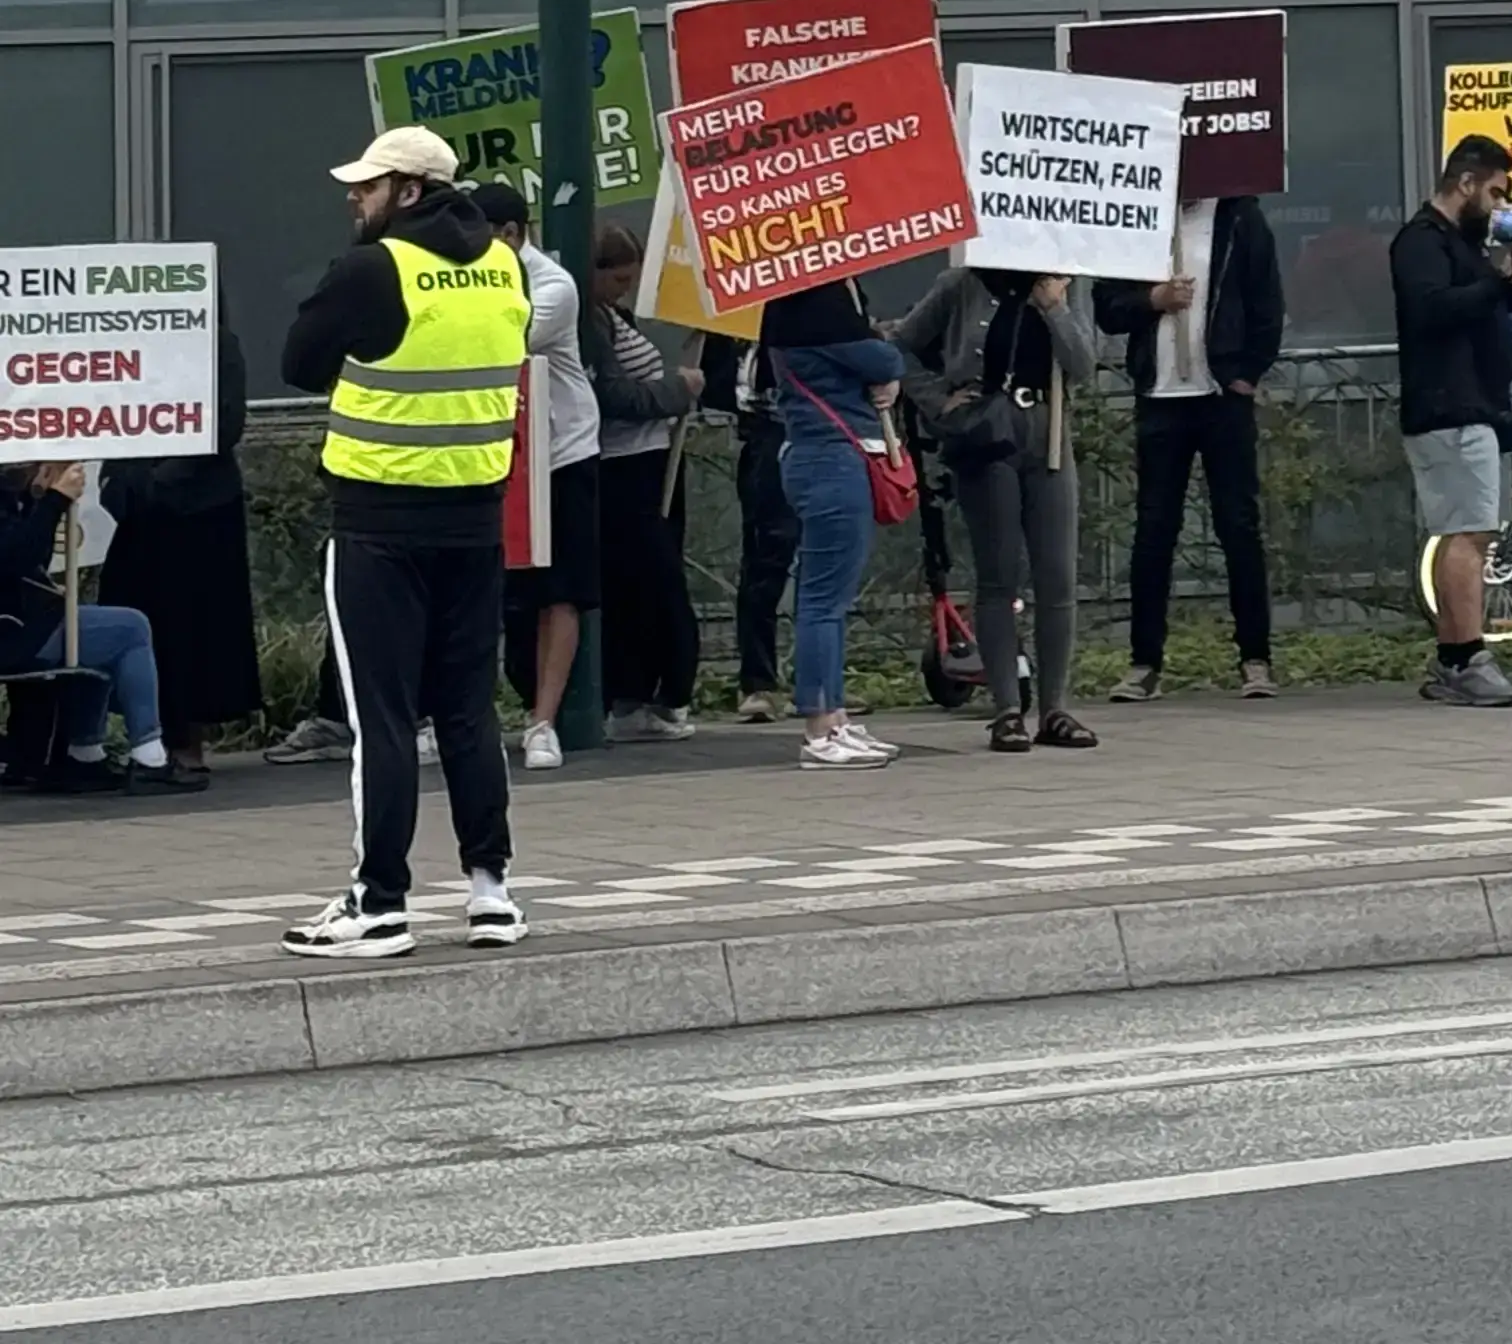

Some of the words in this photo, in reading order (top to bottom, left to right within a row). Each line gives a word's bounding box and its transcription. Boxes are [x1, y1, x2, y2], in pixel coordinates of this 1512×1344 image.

[744, 16, 867, 48] FALSCHE
[678, 99, 765, 143] MEHR
[684, 102, 858, 168] BELASTUNG
[1001, 111, 1150, 149] WIRTSCHAFT
[1207, 110, 1271, 135] JOBS!
[691, 163, 750, 200] FÜR
[756, 115, 921, 182] KOLLEGEN?
[979, 149, 1105, 190] SCHÜTZEN,
[1110, 163, 1163, 192] FAIR
[701, 203, 736, 230] SO
[740, 181, 812, 218] KANN
[816, 171, 847, 196] ES
[980, 191, 1159, 231] KRANKMELDEN!
[707, 195, 850, 270] NICHT
[716, 203, 964, 297] WEITERGEHEN!
[21, 268, 76, 297] EIN
[86, 264, 208, 295] FAIRES
[416, 268, 514, 291] ORDNER
[0, 308, 207, 336] NDHEITSSYSTEM
[6, 350, 141, 385] GEGEN
